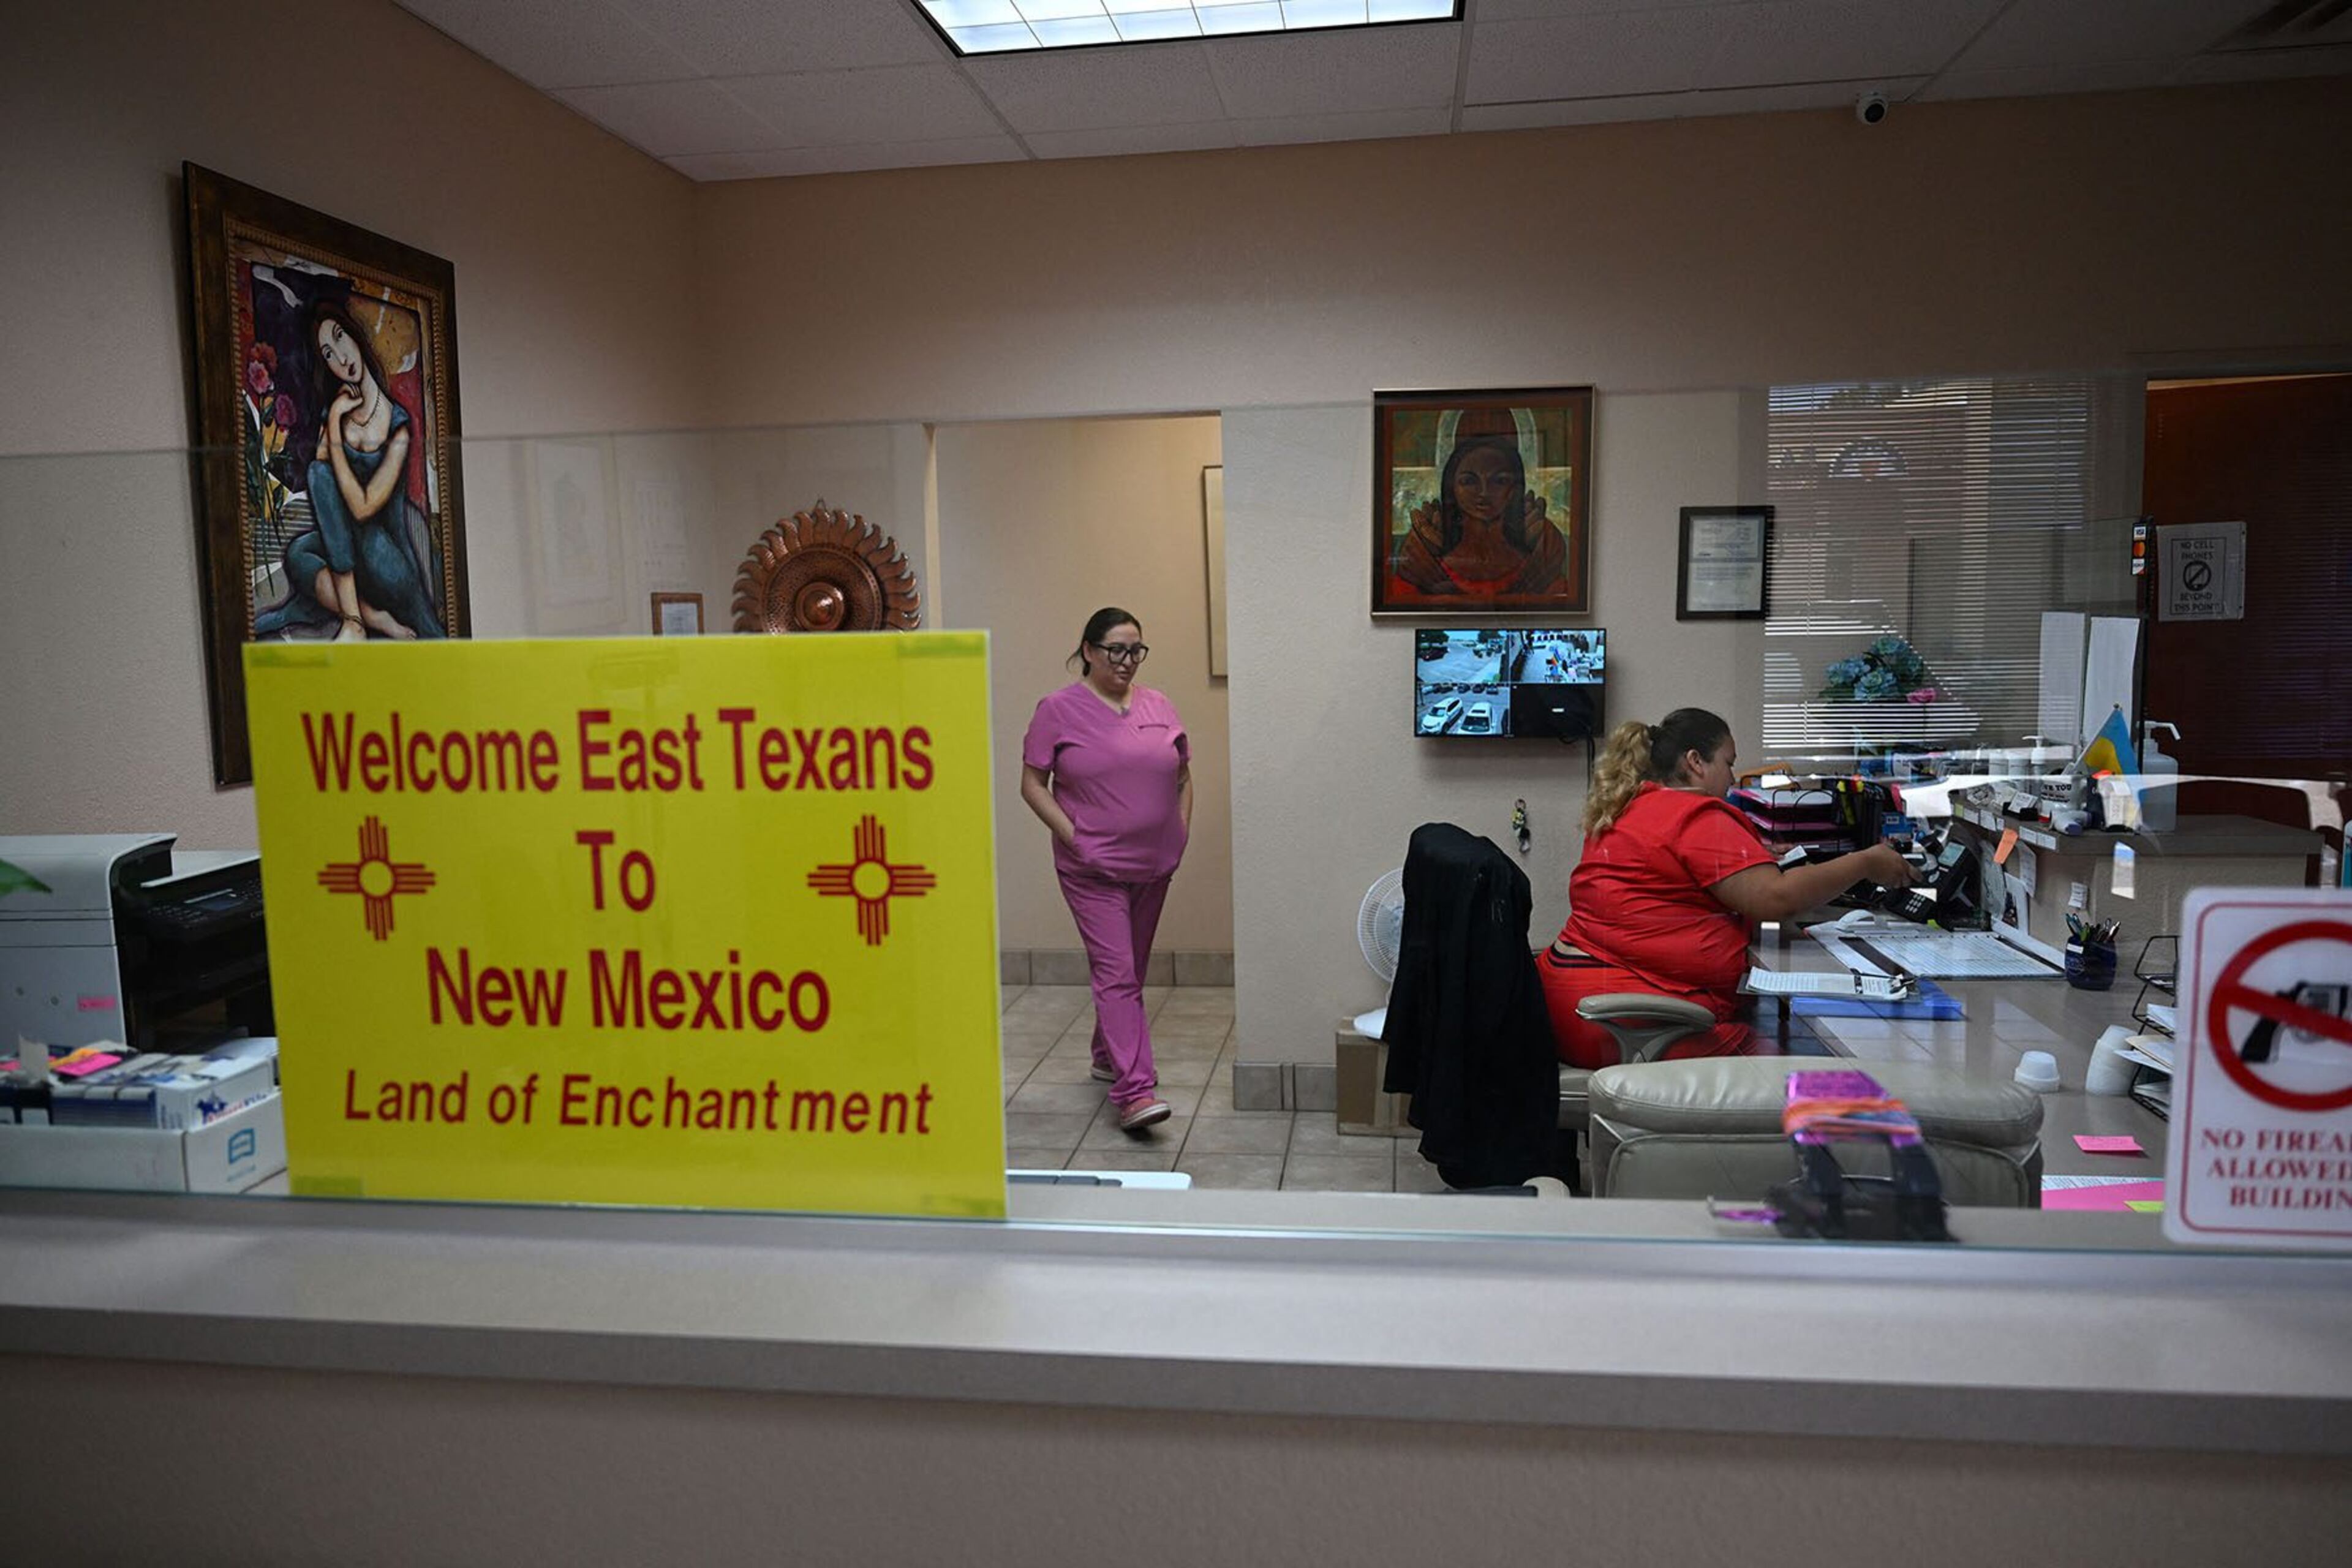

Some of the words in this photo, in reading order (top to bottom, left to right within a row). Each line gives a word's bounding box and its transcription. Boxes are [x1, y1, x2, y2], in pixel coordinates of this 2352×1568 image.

[2194, 540, 2214, 549] CELL
[300, 712, 559, 794] Welcome
[578, 709, 704, 793] East
[718, 708, 934, 792] Texans
[575, 830, 656, 913] To
[426, 947, 567, 1028] New
[588, 948, 831, 1033] Mexico
[344, 1069, 469, 1123] Land
[488, 1073, 538, 1124] of
[559, 1073, 932, 1134] Enchantment
[2201, 1129, 2245, 1149] NO
[2256, 1129, 2352, 1152] FIREA
[2230, 1186, 2352, 1210] BUILDIN
